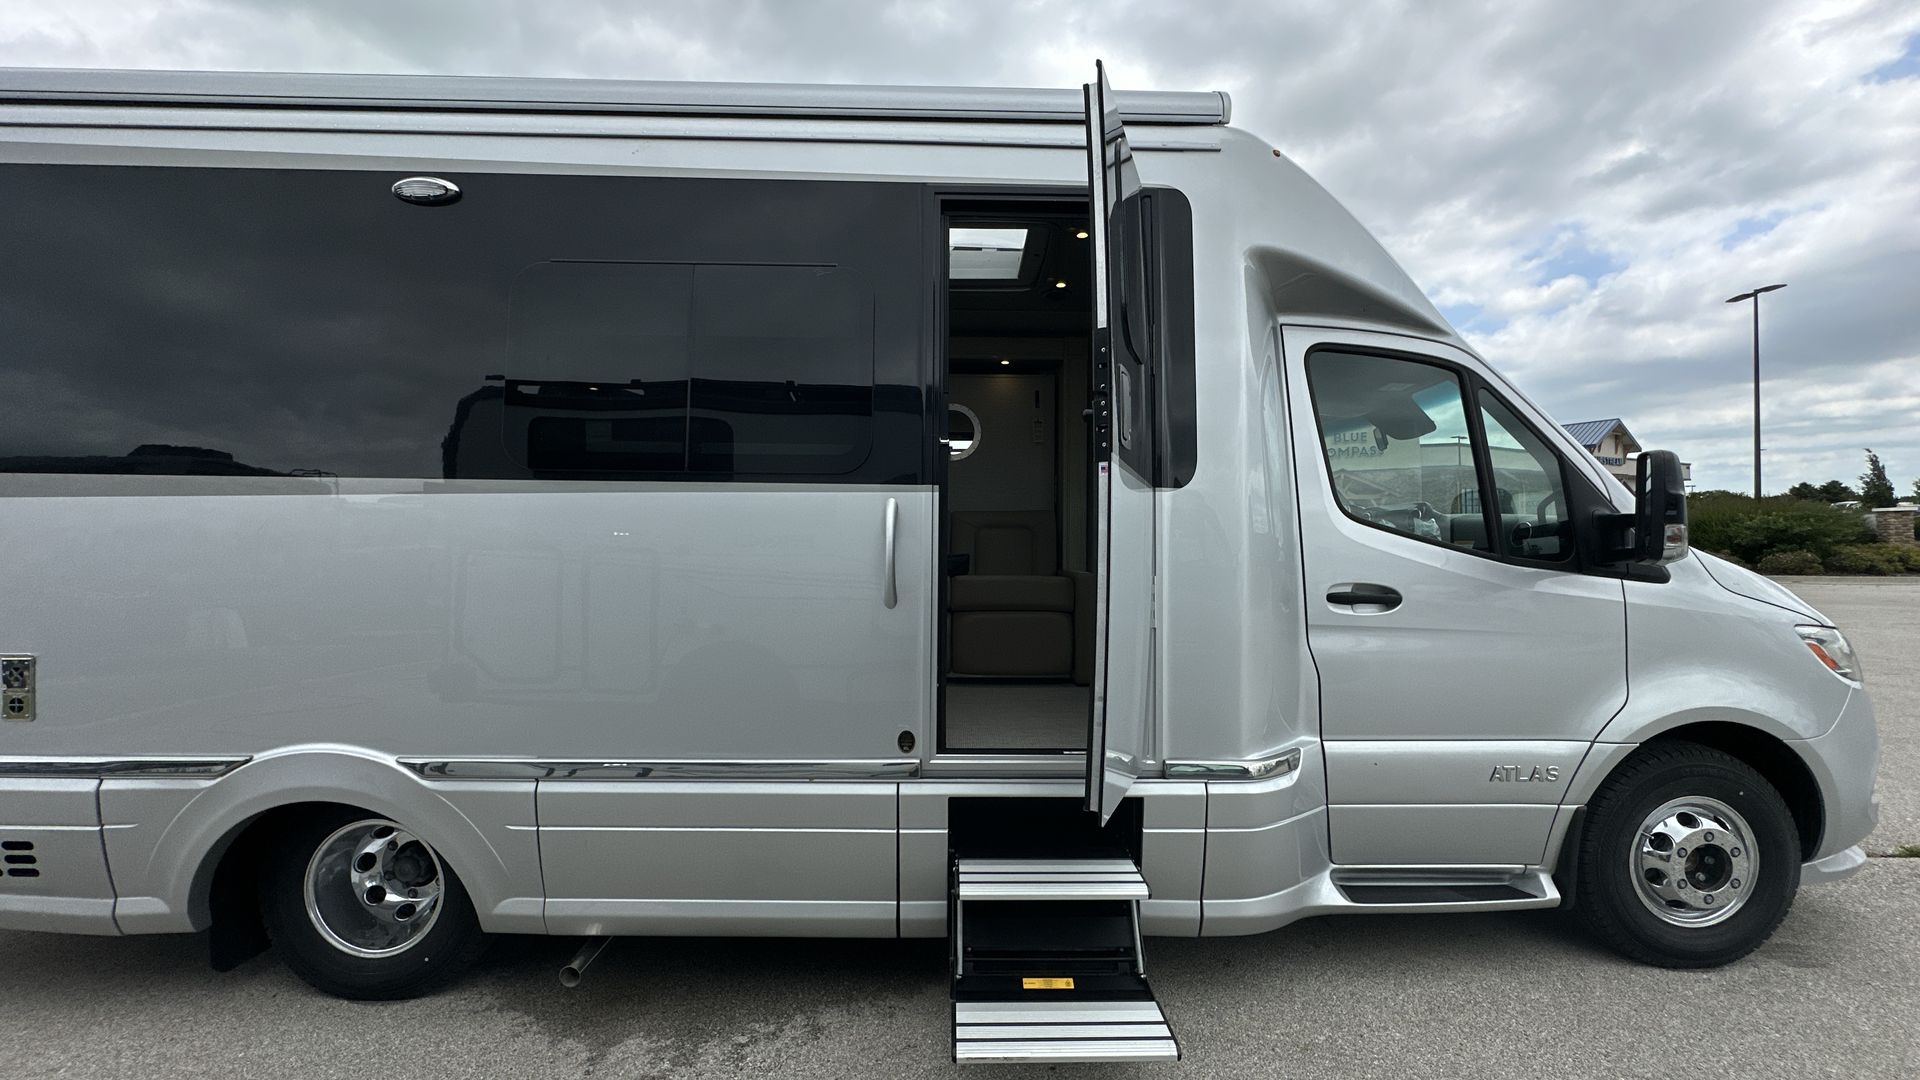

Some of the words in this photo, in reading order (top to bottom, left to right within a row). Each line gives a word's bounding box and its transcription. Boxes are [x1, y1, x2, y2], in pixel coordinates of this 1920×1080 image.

[1334, 432, 1367, 442] BLUE
[1328, 445, 1384, 457] OMPAS
[1489, 765, 1559, 782] ATLAS
